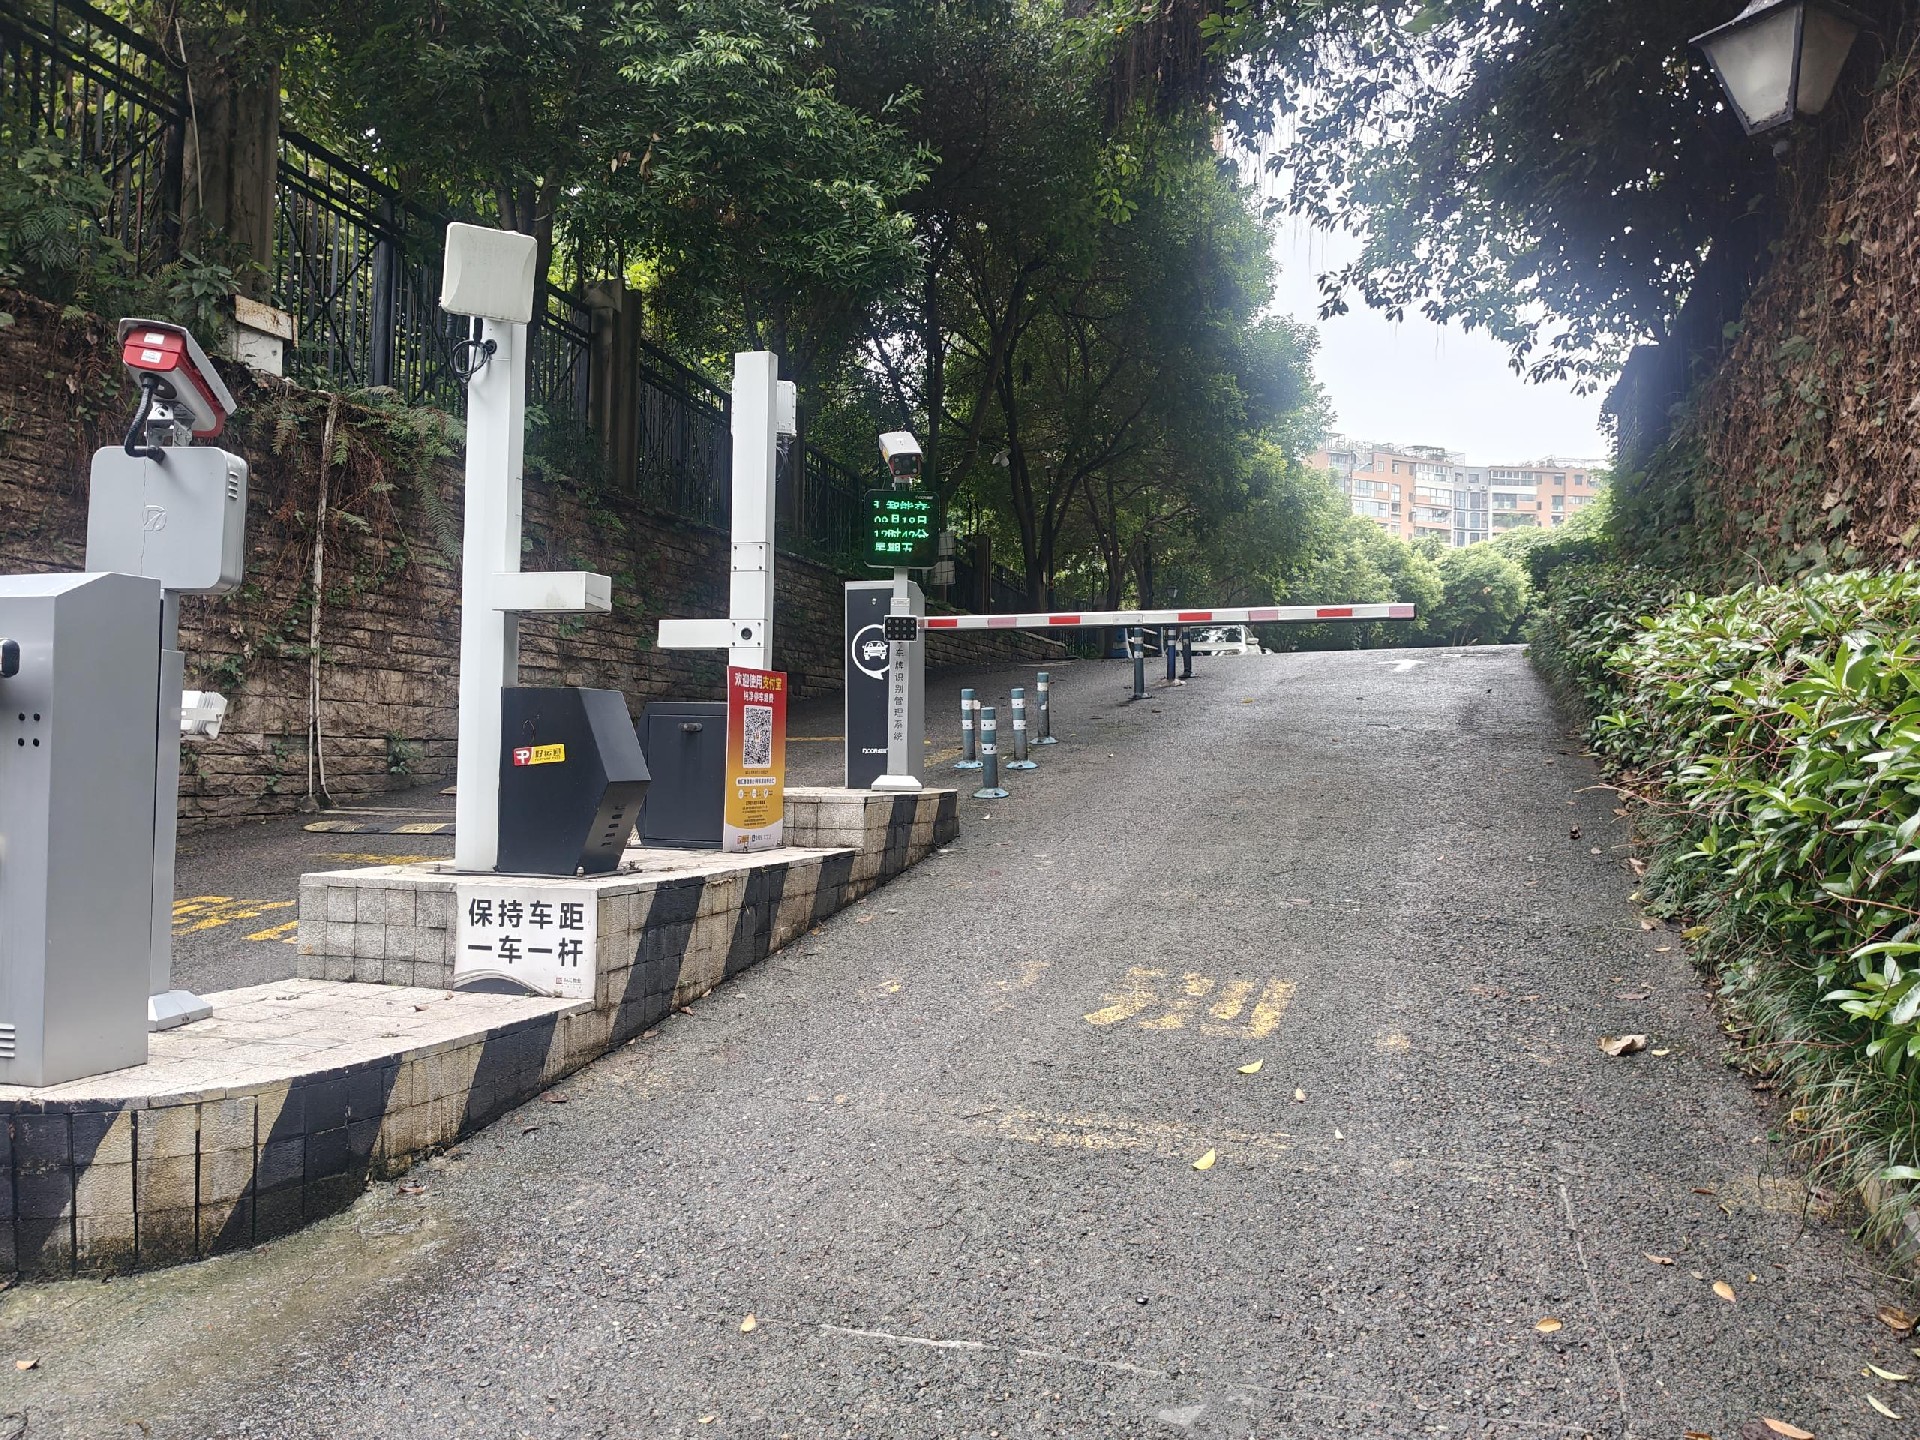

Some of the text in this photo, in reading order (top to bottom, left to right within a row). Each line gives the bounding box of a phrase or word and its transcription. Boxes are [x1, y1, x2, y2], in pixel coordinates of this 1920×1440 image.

[734, 672, 782, 691] 欢迎使用支付宝
[468, 898, 584, 930] 保持车距
[467, 935, 584, 967] 一车一杆
